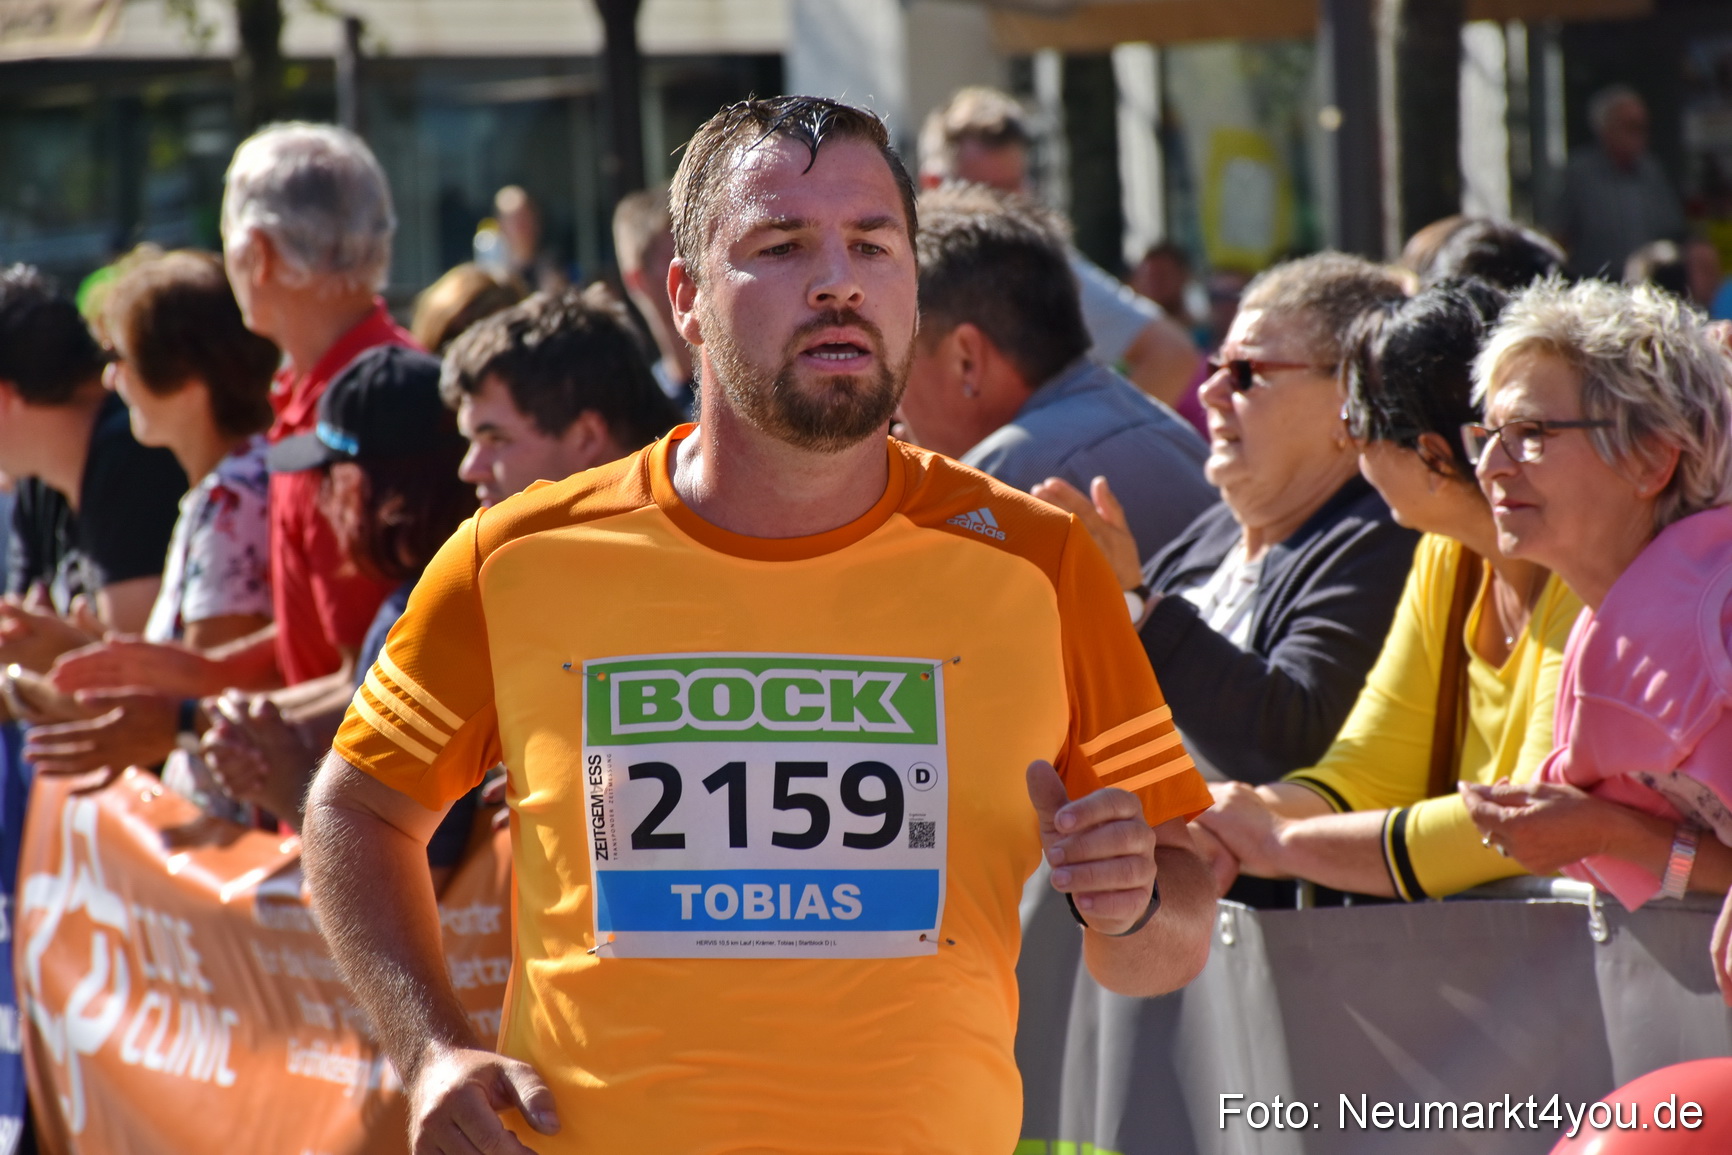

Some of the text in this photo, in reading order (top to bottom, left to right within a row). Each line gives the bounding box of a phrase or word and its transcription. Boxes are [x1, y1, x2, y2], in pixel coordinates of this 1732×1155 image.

[946, 518, 1006, 541] adidas
[612, 670, 911, 733] BOCK
[606, 753, 618, 861] TRANSPONDER ZEITMESSUNG
[628, 760, 904, 850] 2159
[915, 768, 931, 784] D
[671, 883, 863, 921] TOBIAS
[120, 990, 240, 1088] CLINIC
